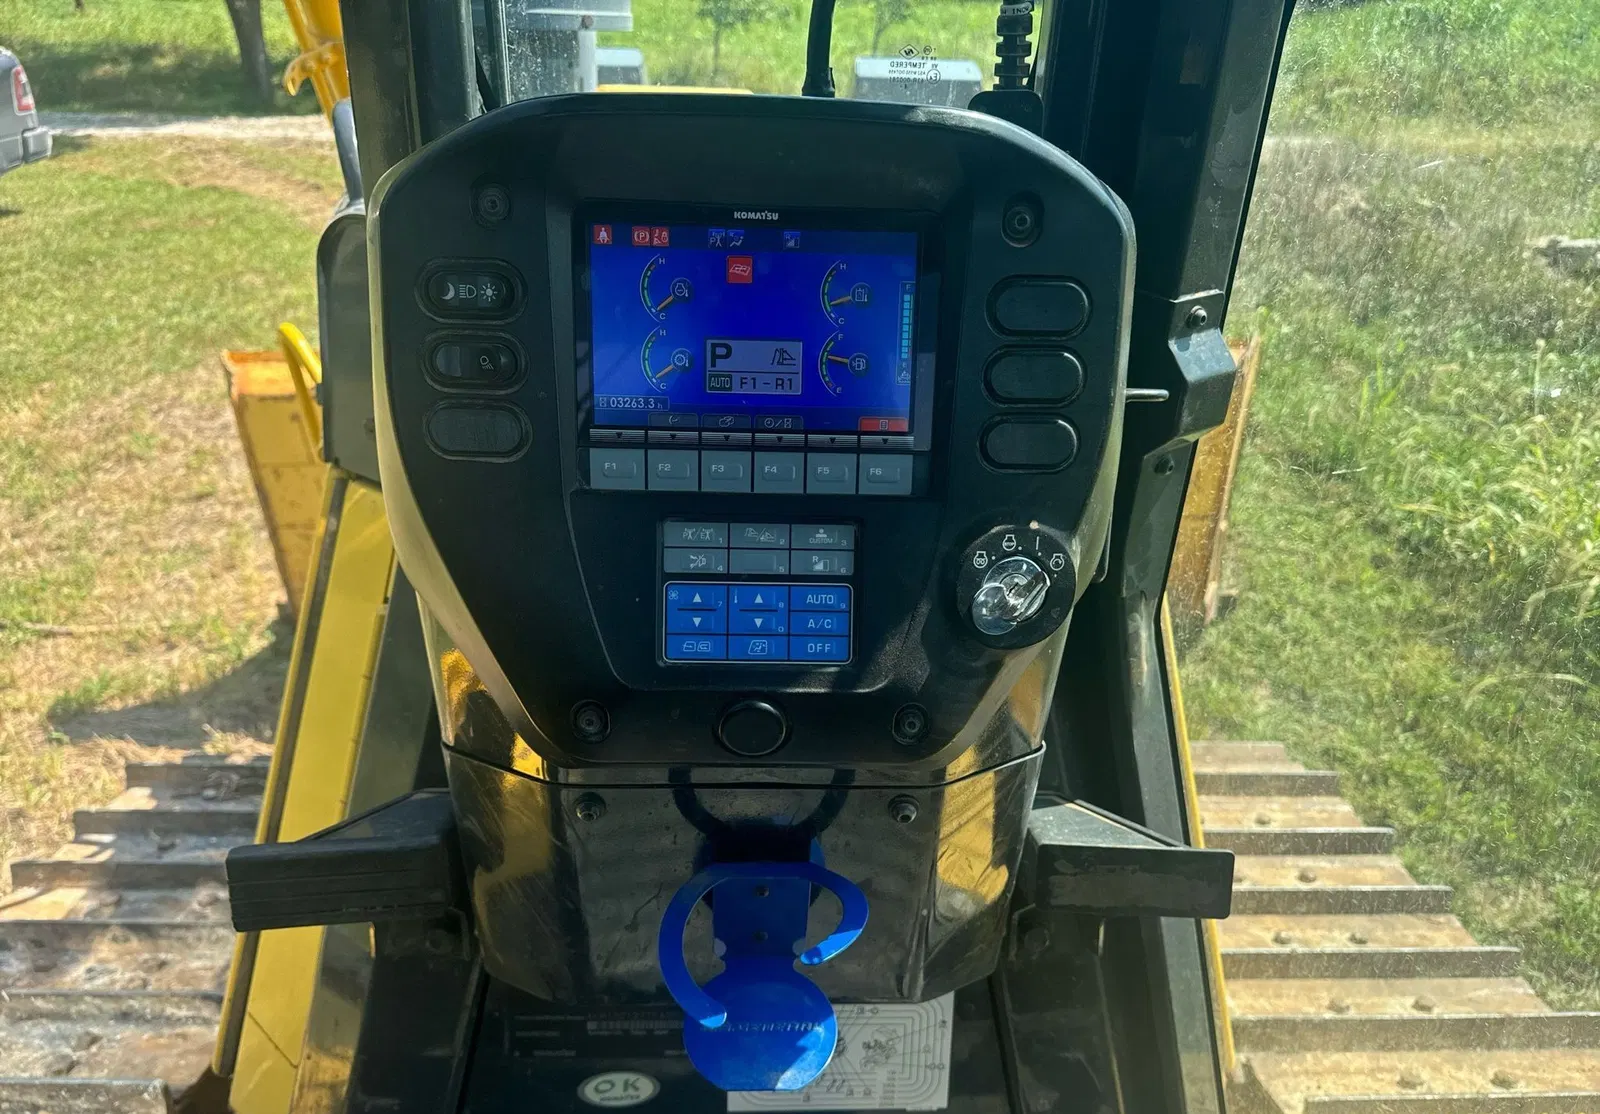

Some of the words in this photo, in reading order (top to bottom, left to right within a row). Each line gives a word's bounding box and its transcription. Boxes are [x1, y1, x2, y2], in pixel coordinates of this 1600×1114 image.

[733, 210, 779, 221] KOMATSU
[659, 312, 666, 320] C
[838, 317, 845, 325] C
[710, 342, 733, 368] P
[659, 382, 667, 390] C
[709, 377, 732, 389] AUTO
[609, 397, 655, 410] 03263.3
[604, 462, 617, 470] F1
[658, 463, 671, 471] F2
[711, 464, 724, 472] F3
[764, 465, 777, 473] F4
[817, 466, 830, 474] F5
[869, 467, 882, 475] F6
[812, 555, 819, 563] R
[806, 594, 834, 605] AUTO
[807, 618, 832, 629] A/C
[807, 643, 831, 653] OFF
[594, 1077, 640, 1093] OK
